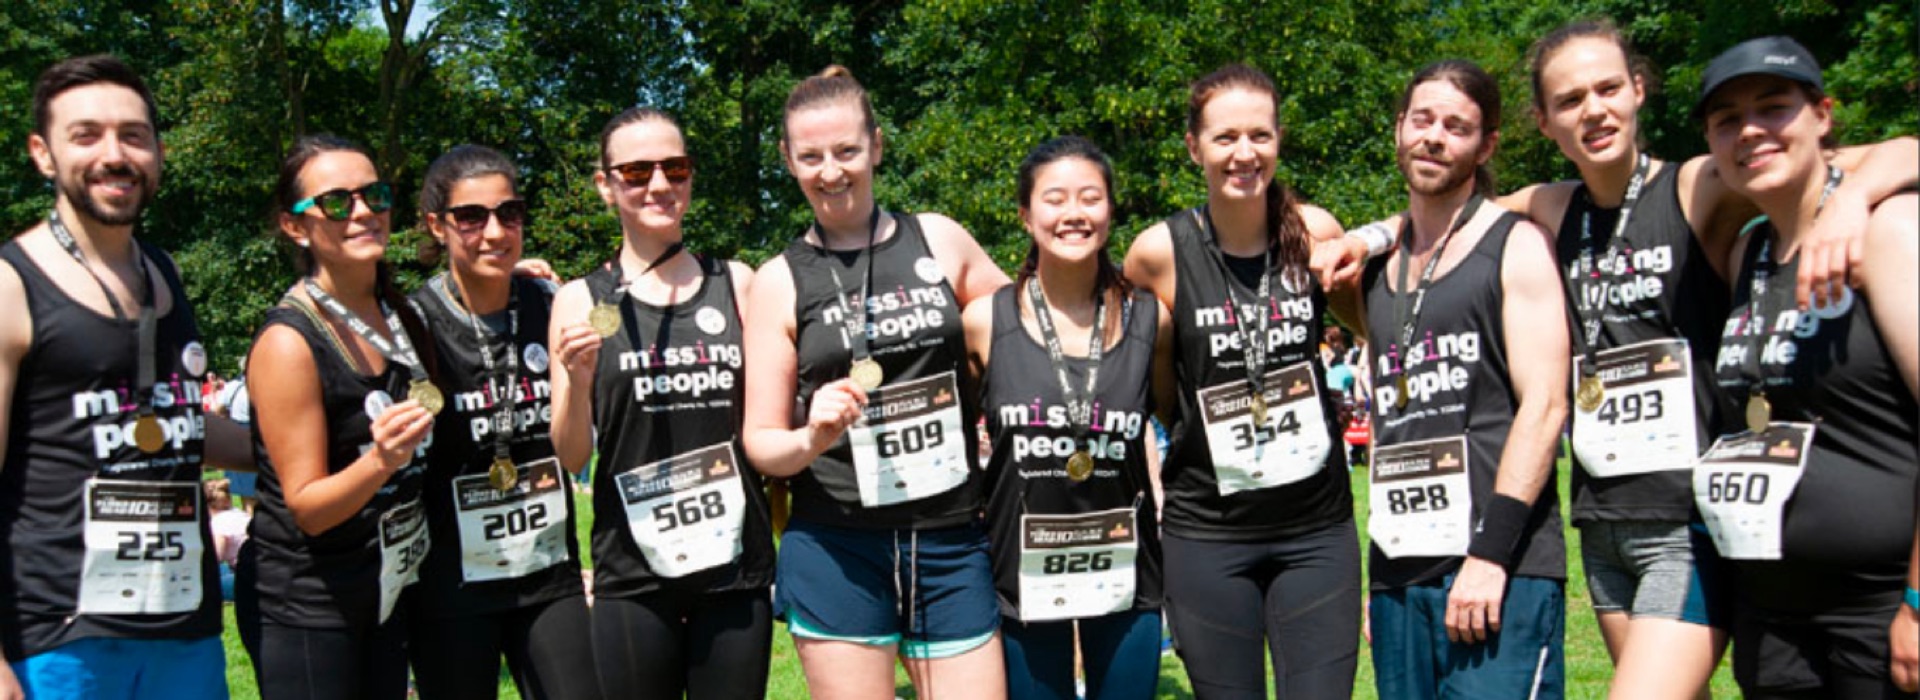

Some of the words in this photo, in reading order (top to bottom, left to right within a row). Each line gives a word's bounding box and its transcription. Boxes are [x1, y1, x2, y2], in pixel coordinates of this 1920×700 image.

[619, 339, 742, 372] missing
[633, 365, 734, 402] people
[1375, 361, 1469, 416] pople
[1000, 398, 1143, 440] mising
[1598, 390, 1664, 426] 493
[876, 420, 944, 458] 609
[1387, 483, 1450, 516] 828
[1709, 472, 1770, 505] 660
[483, 503, 549, 541] 202
[653, 490, 726, 534] 568
[116, 531, 186, 561] 225
[1043, 551, 1114, 575] 826
